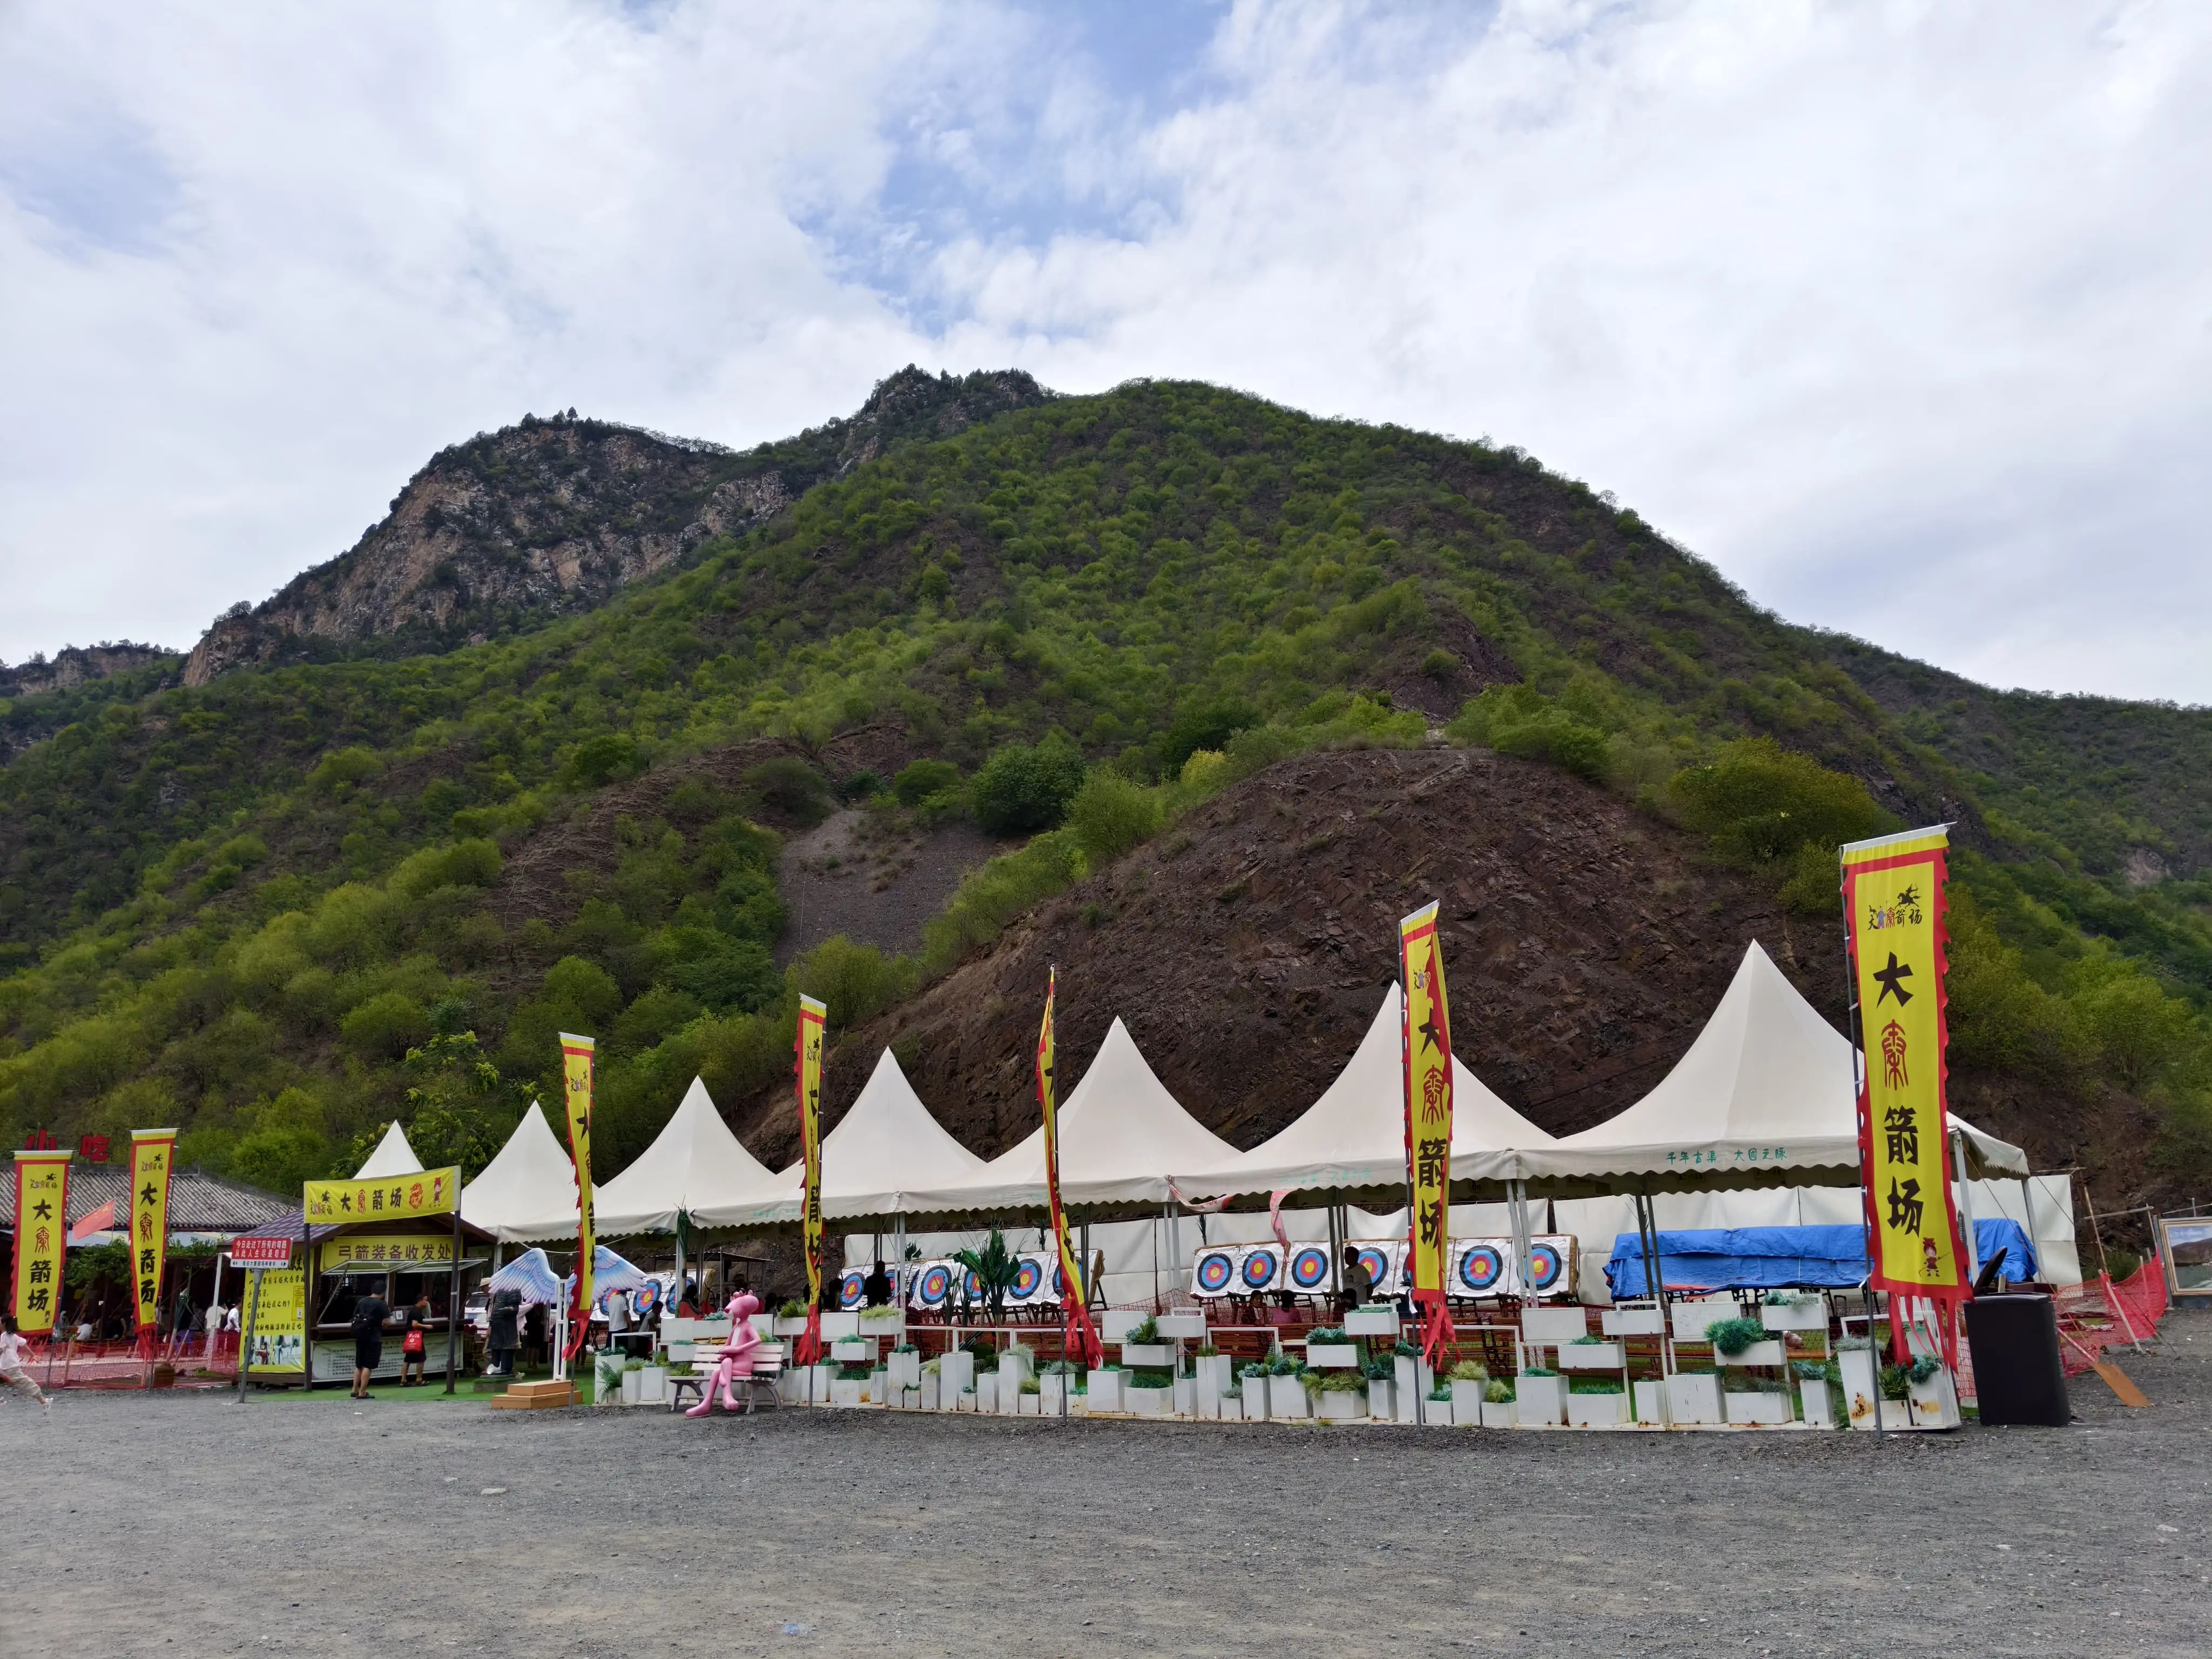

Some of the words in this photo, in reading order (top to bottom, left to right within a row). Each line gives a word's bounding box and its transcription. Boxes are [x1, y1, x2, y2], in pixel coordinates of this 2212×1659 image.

[339, 1244, 451, 1260] 弓箭装备收发处
